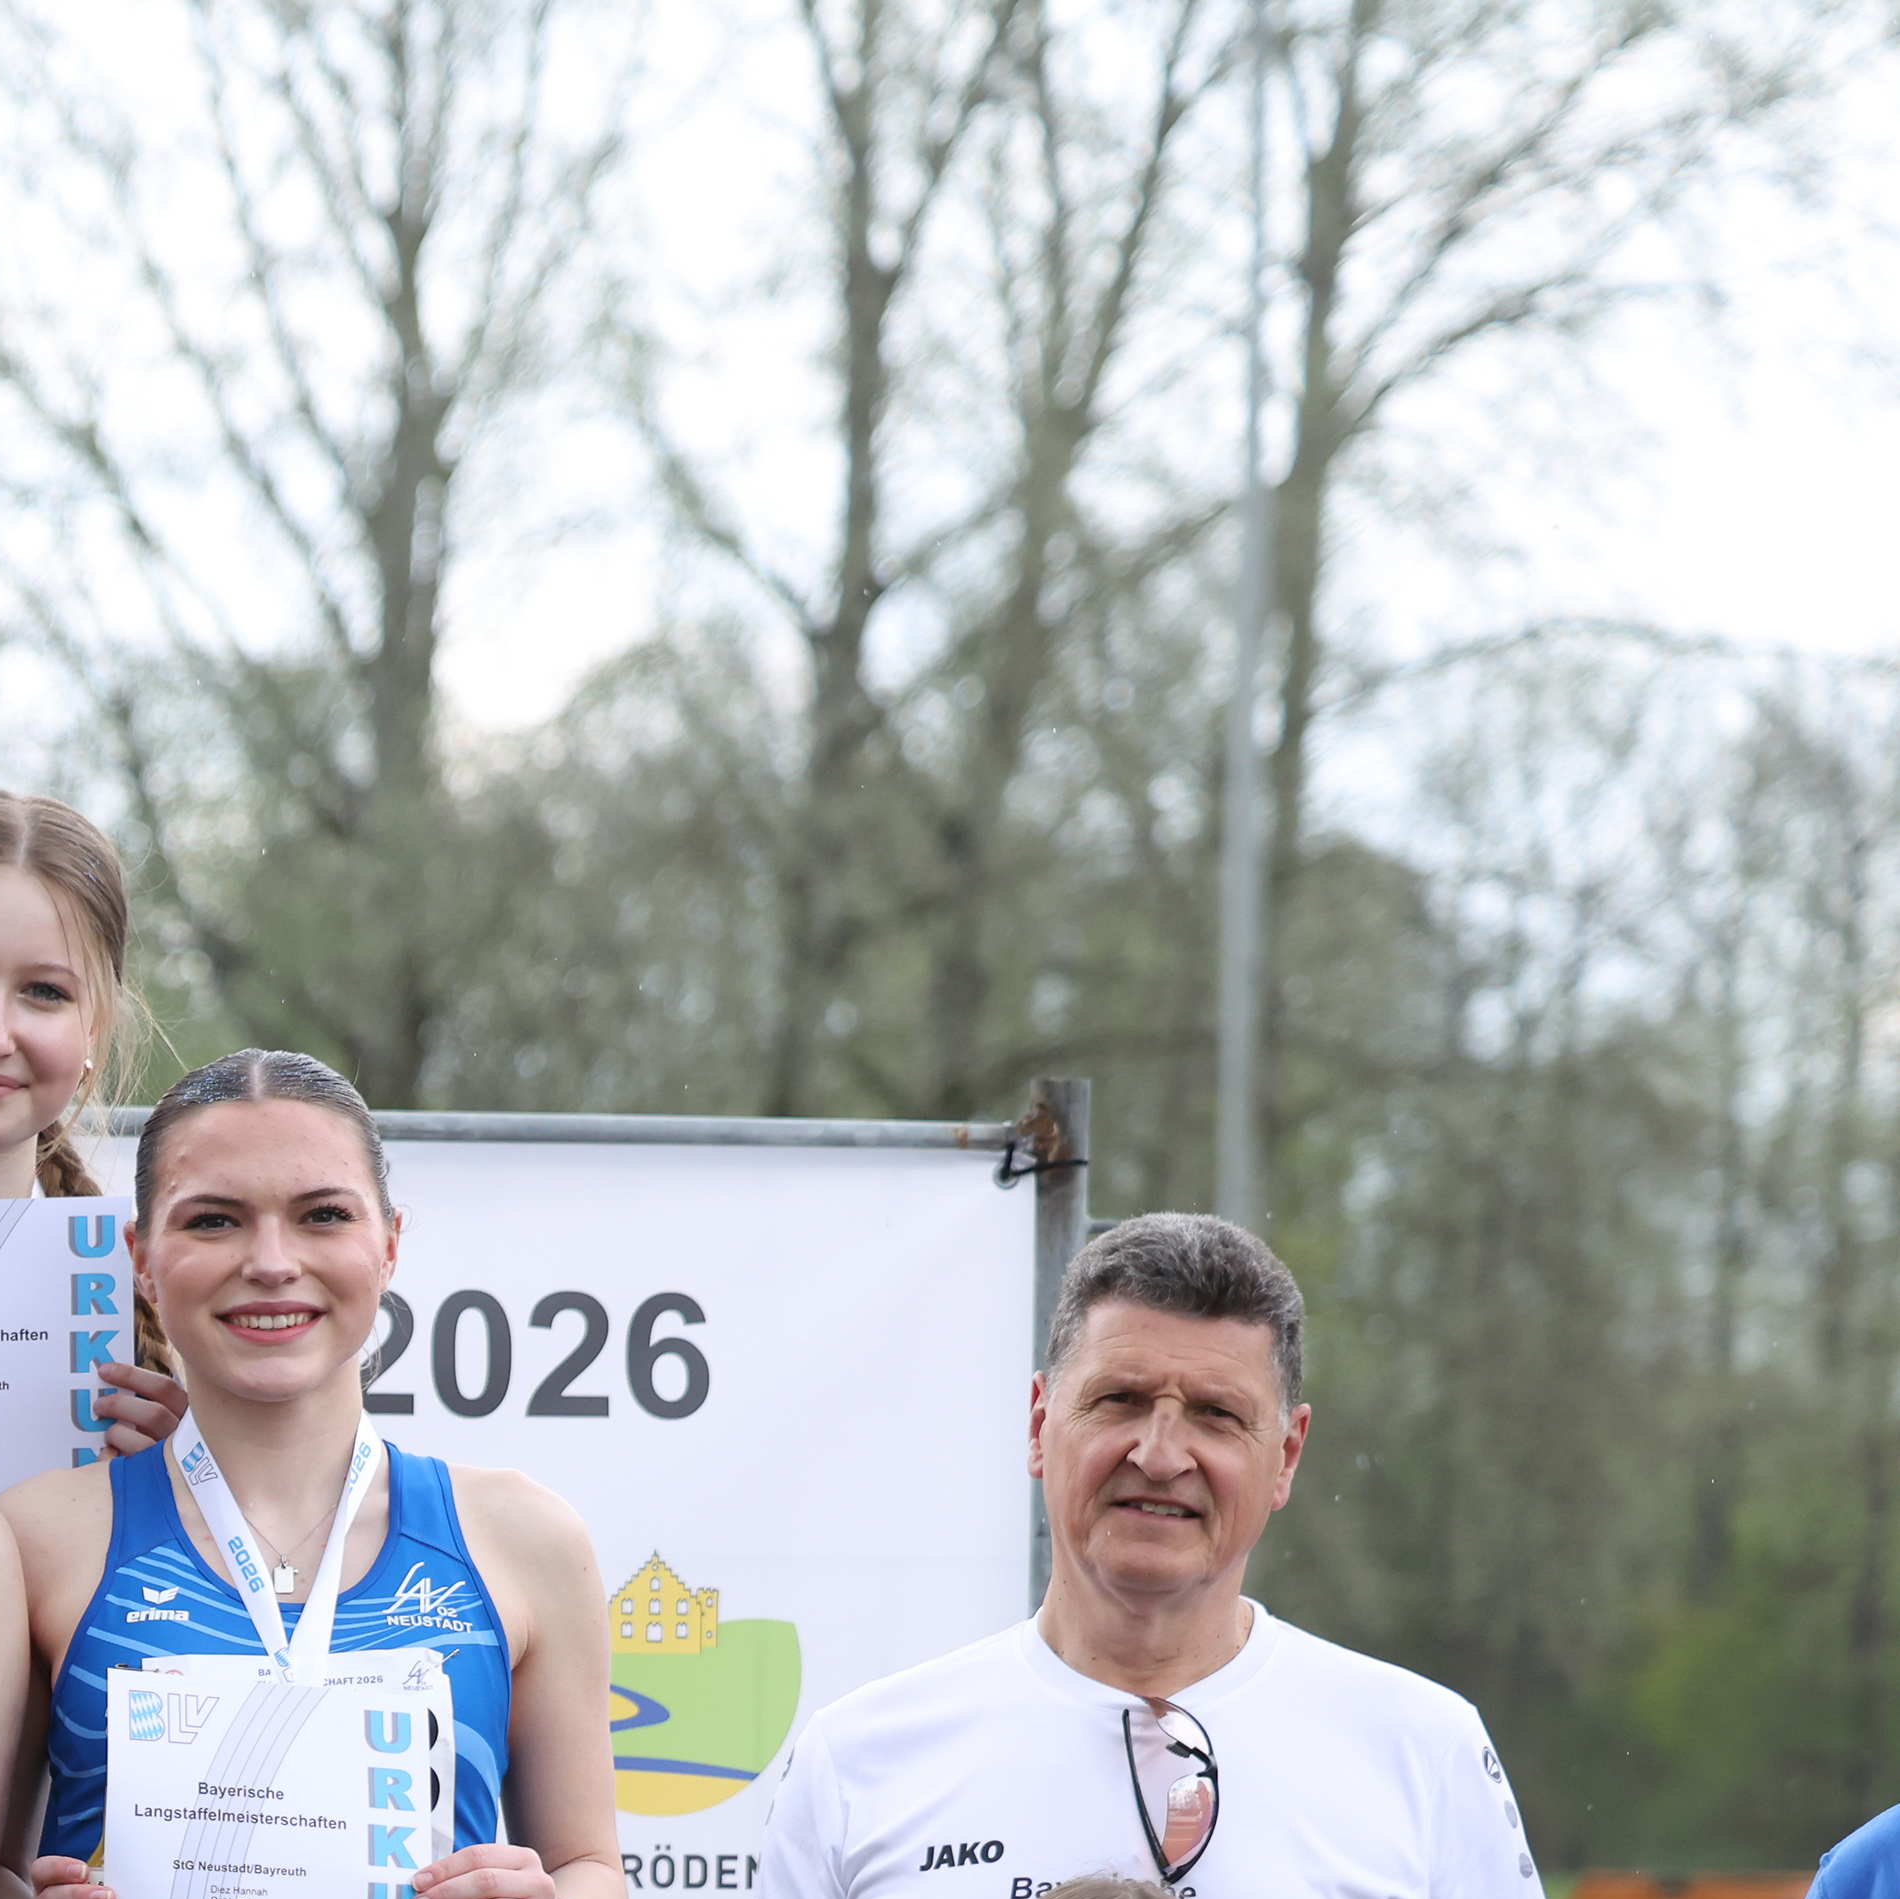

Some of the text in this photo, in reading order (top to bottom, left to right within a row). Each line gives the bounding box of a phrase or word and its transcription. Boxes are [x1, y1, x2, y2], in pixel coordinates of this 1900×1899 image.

[363, 1288, 710, 1420] 2026
[227, 1536, 265, 1594] 2026
[126, 1607, 189, 1624] erima
[437, 1606, 458, 1617] 02
[386, 1615, 473, 1633] NEUSTADT
[354, 1674, 384, 1686] 2026
[129, 1689, 219, 1745] BLV
[197, 1782, 285, 1801] Bayerische
[134, 1804, 347, 1832] Langstaffelmeisterschaften
[920, 1840, 1005, 1872] JAKO
[172, 1859, 307, 1878] StG Neustadt/Bayreuth
